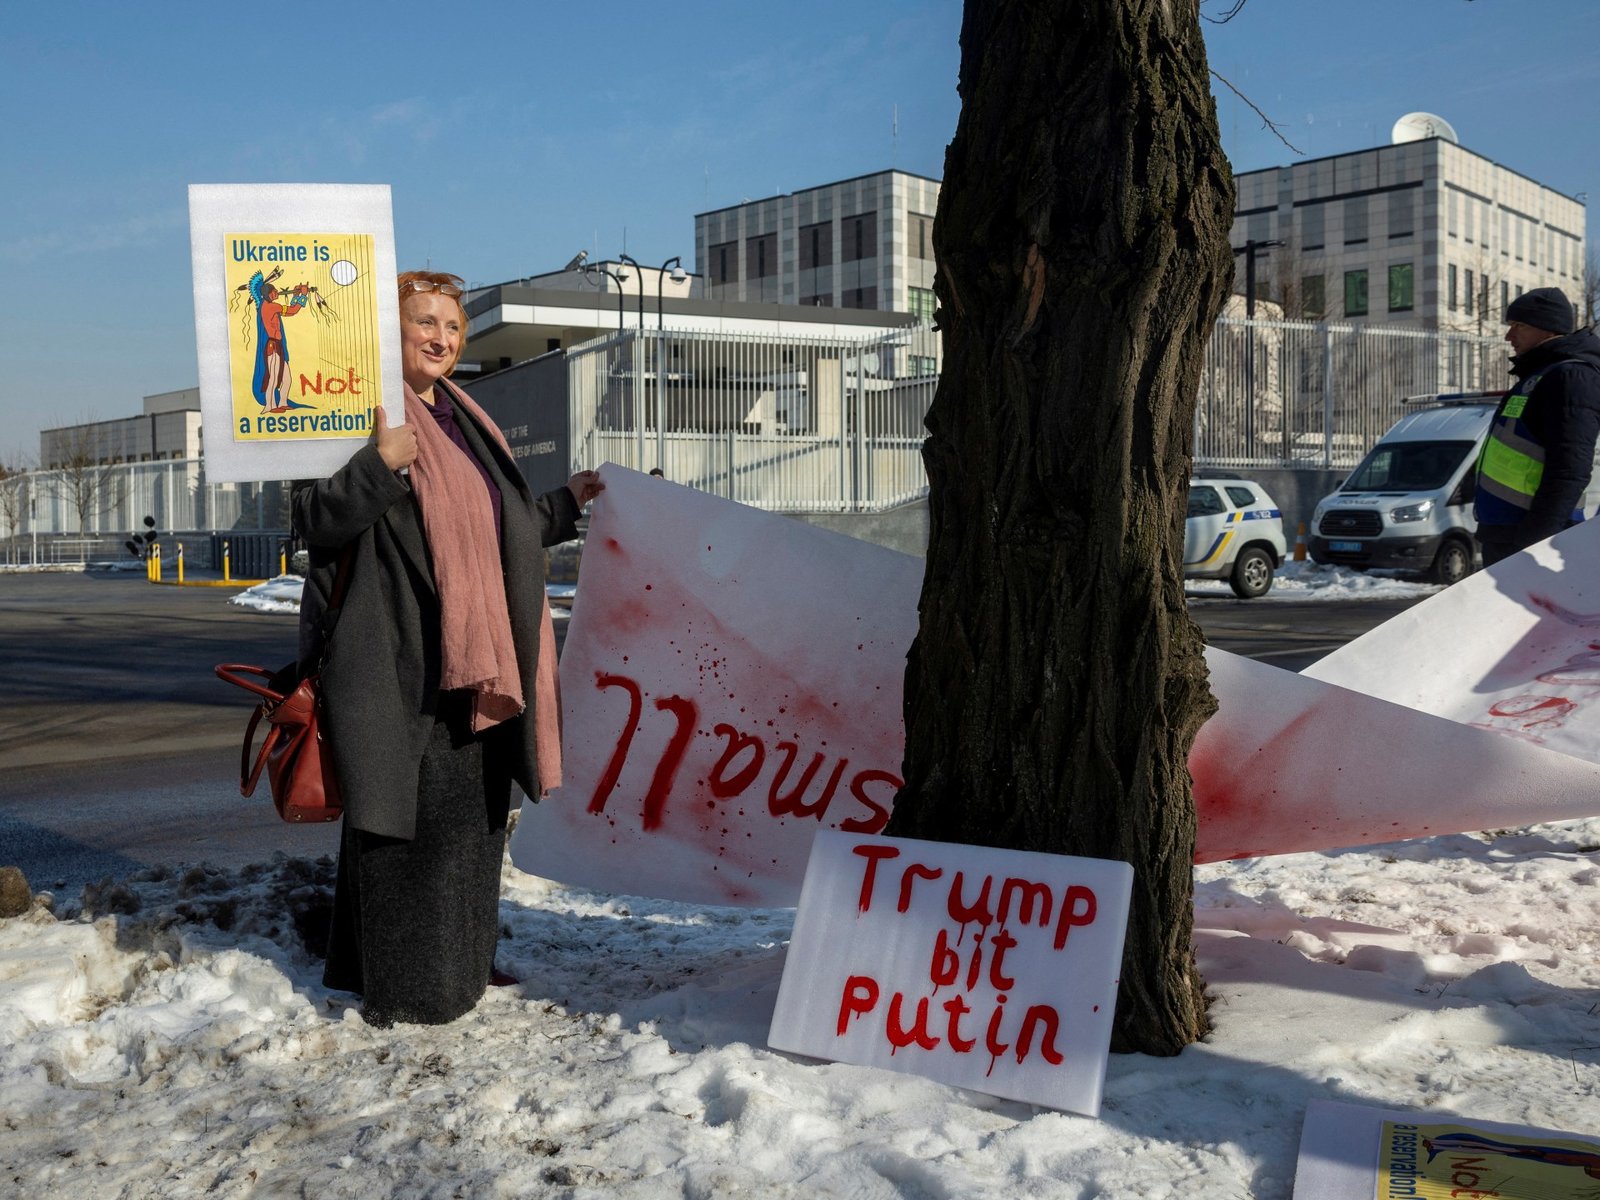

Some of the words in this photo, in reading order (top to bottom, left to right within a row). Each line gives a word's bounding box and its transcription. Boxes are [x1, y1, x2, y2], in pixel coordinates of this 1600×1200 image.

[232, 239, 307, 262] Ukraine
[313, 240, 331, 262] is
[299, 367, 362, 397] Not
[239, 416, 251, 434] a
[257, 408, 373, 433] reservation!
[518, 424, 528, 437] THE
[531, 440, 556, 455] AMERICA
[852, 845, 1098, 950] Trump
[930, 929, 1018, 994] bit
[1449, 1156, 1500, 1199] Not
